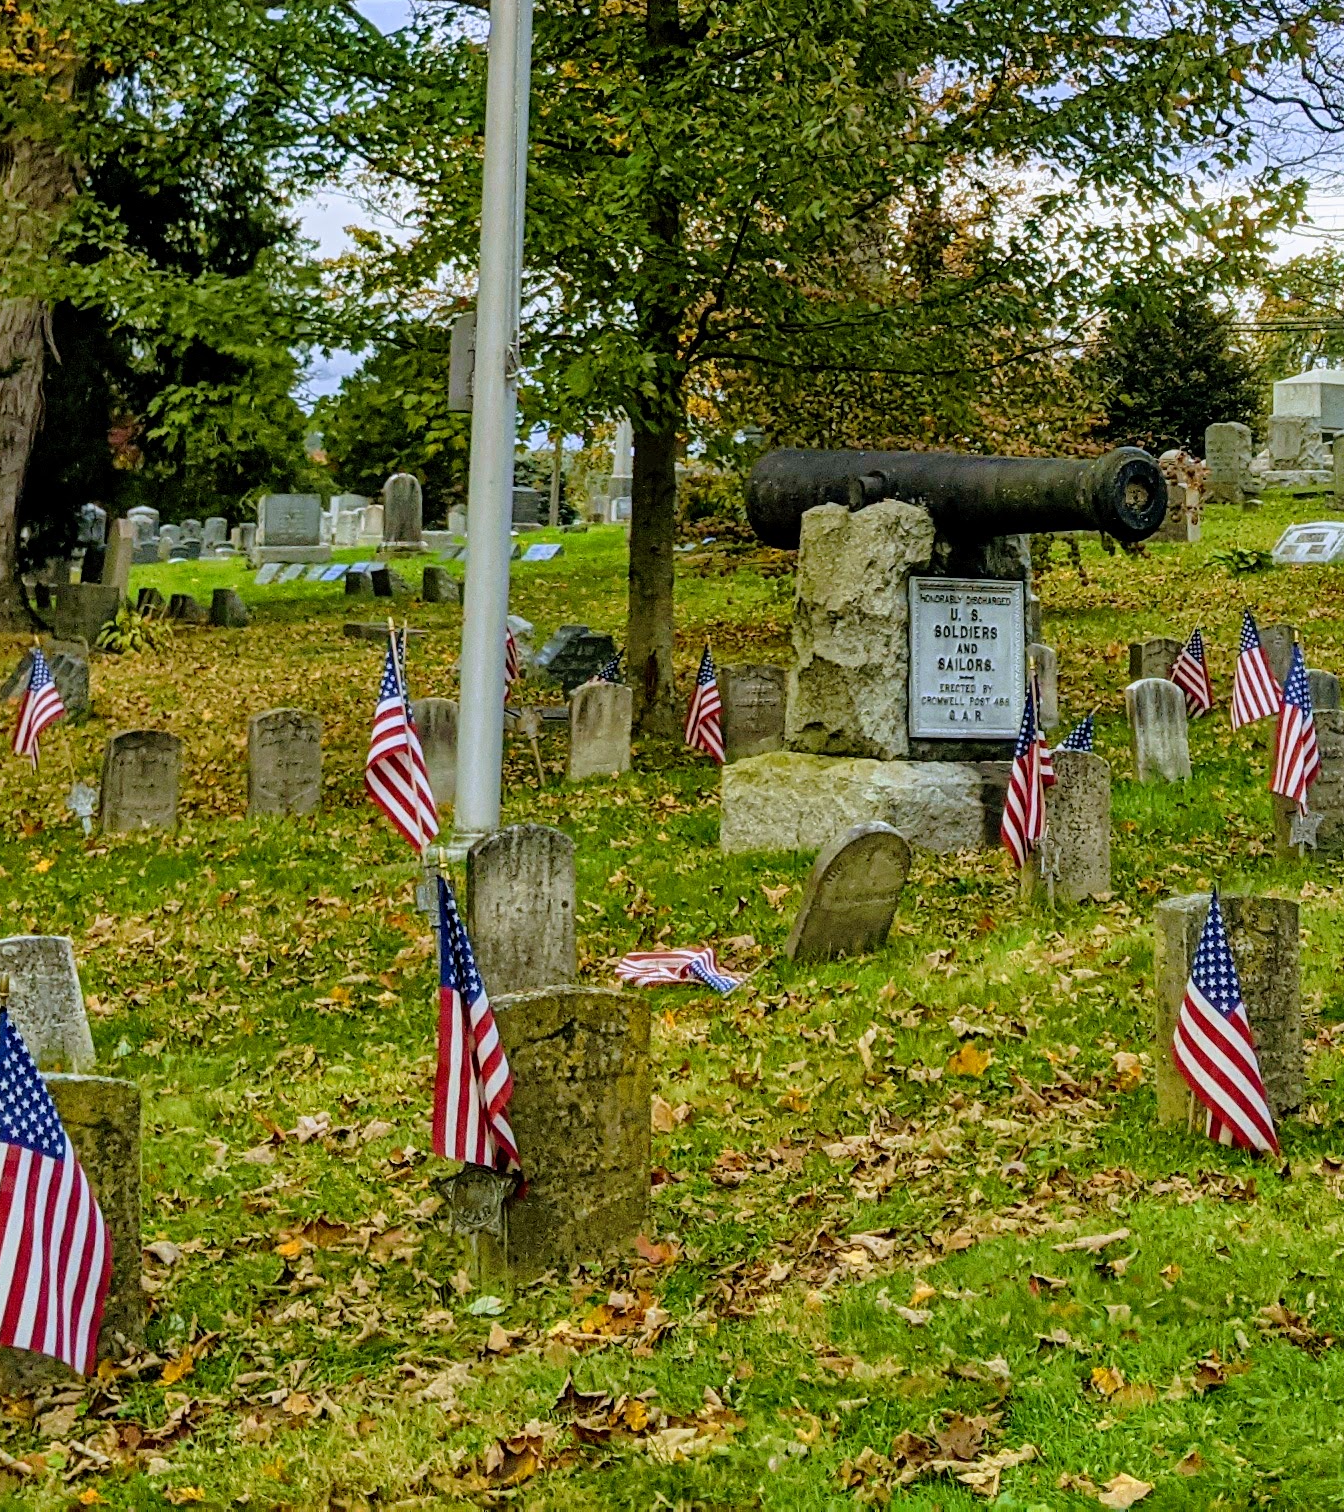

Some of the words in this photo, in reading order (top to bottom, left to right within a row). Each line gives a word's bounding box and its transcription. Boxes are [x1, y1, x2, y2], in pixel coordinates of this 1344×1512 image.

[920, 593, 962, 604] HONORABLY
[965, 595, 1011, 606] DISCHARGED
[950, 608, 962, 622] U.
[970, 608, 983, 623] S.
[934, 624, 998, 640] SOLDIERS
[956, 643, 978, 654] AND
[937, 657, 996, 672] SAILORS.
[939, 683, 977, 694] ERECTED
[982, 684, 993, 694] BY
[921, 695, 965, 706] CROMWELL
[969, 696, 991, 706] POST
